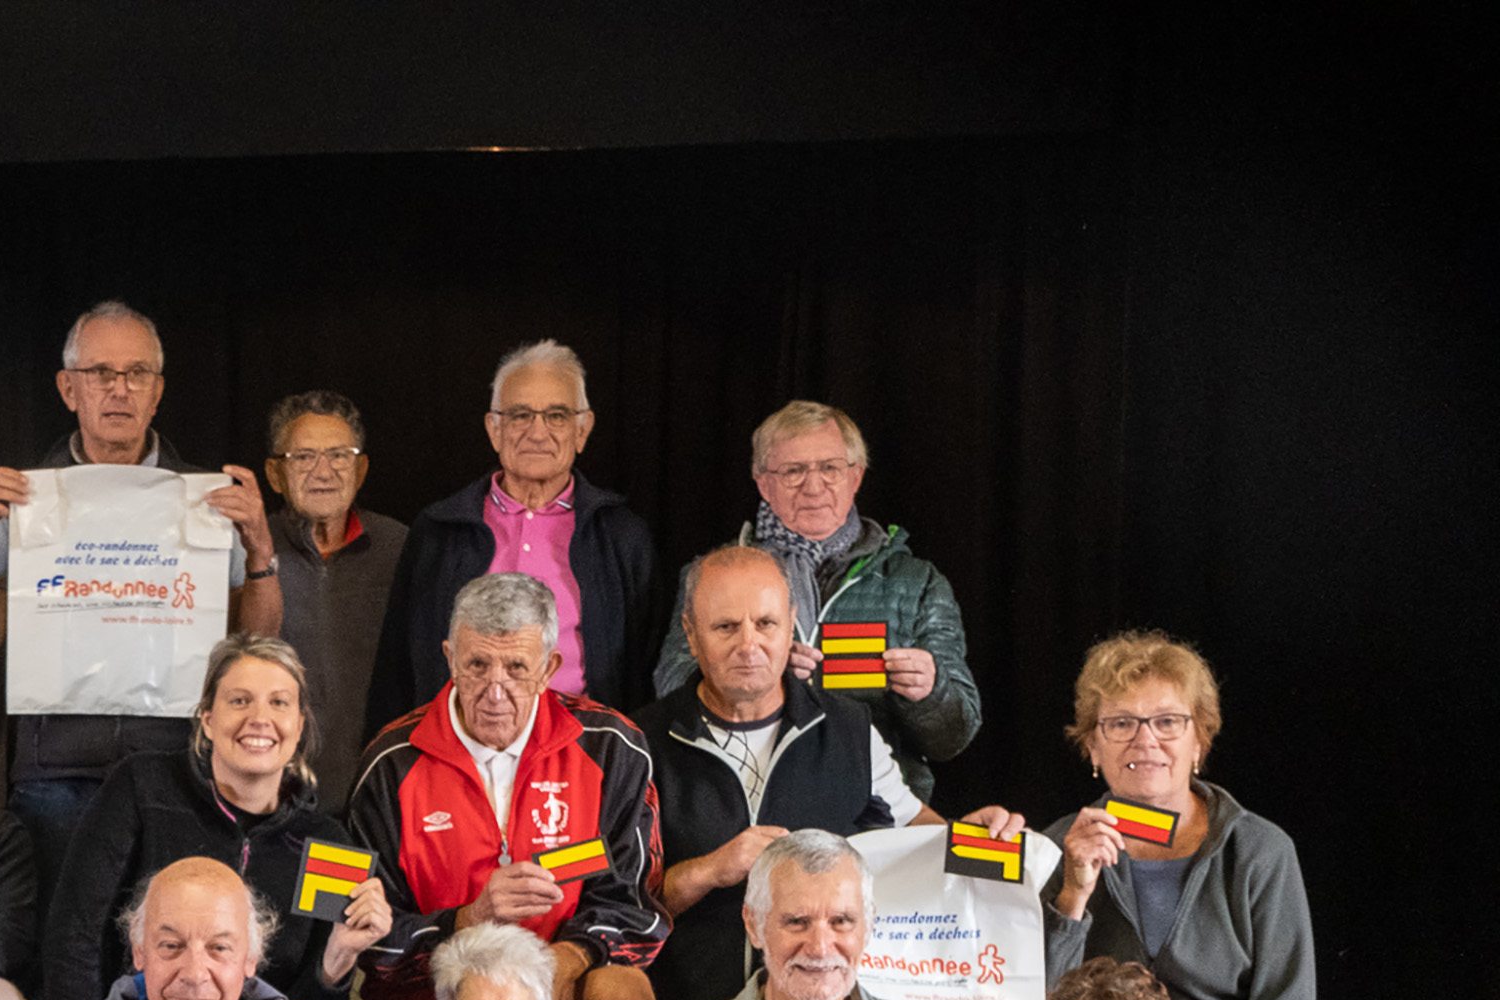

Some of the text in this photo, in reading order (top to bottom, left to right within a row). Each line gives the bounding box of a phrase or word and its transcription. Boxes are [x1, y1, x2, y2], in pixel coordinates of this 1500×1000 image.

[74, 540, 160, 552] éco-randonnez
[54, 553, 179, 566] avec le sac à déchets
[874, 911, 958, 924] o-randonnez
[889, 930, 910, 940] sac
[915, 928, 924, 940] à
[860, 952, 972, 977] Randonnée
